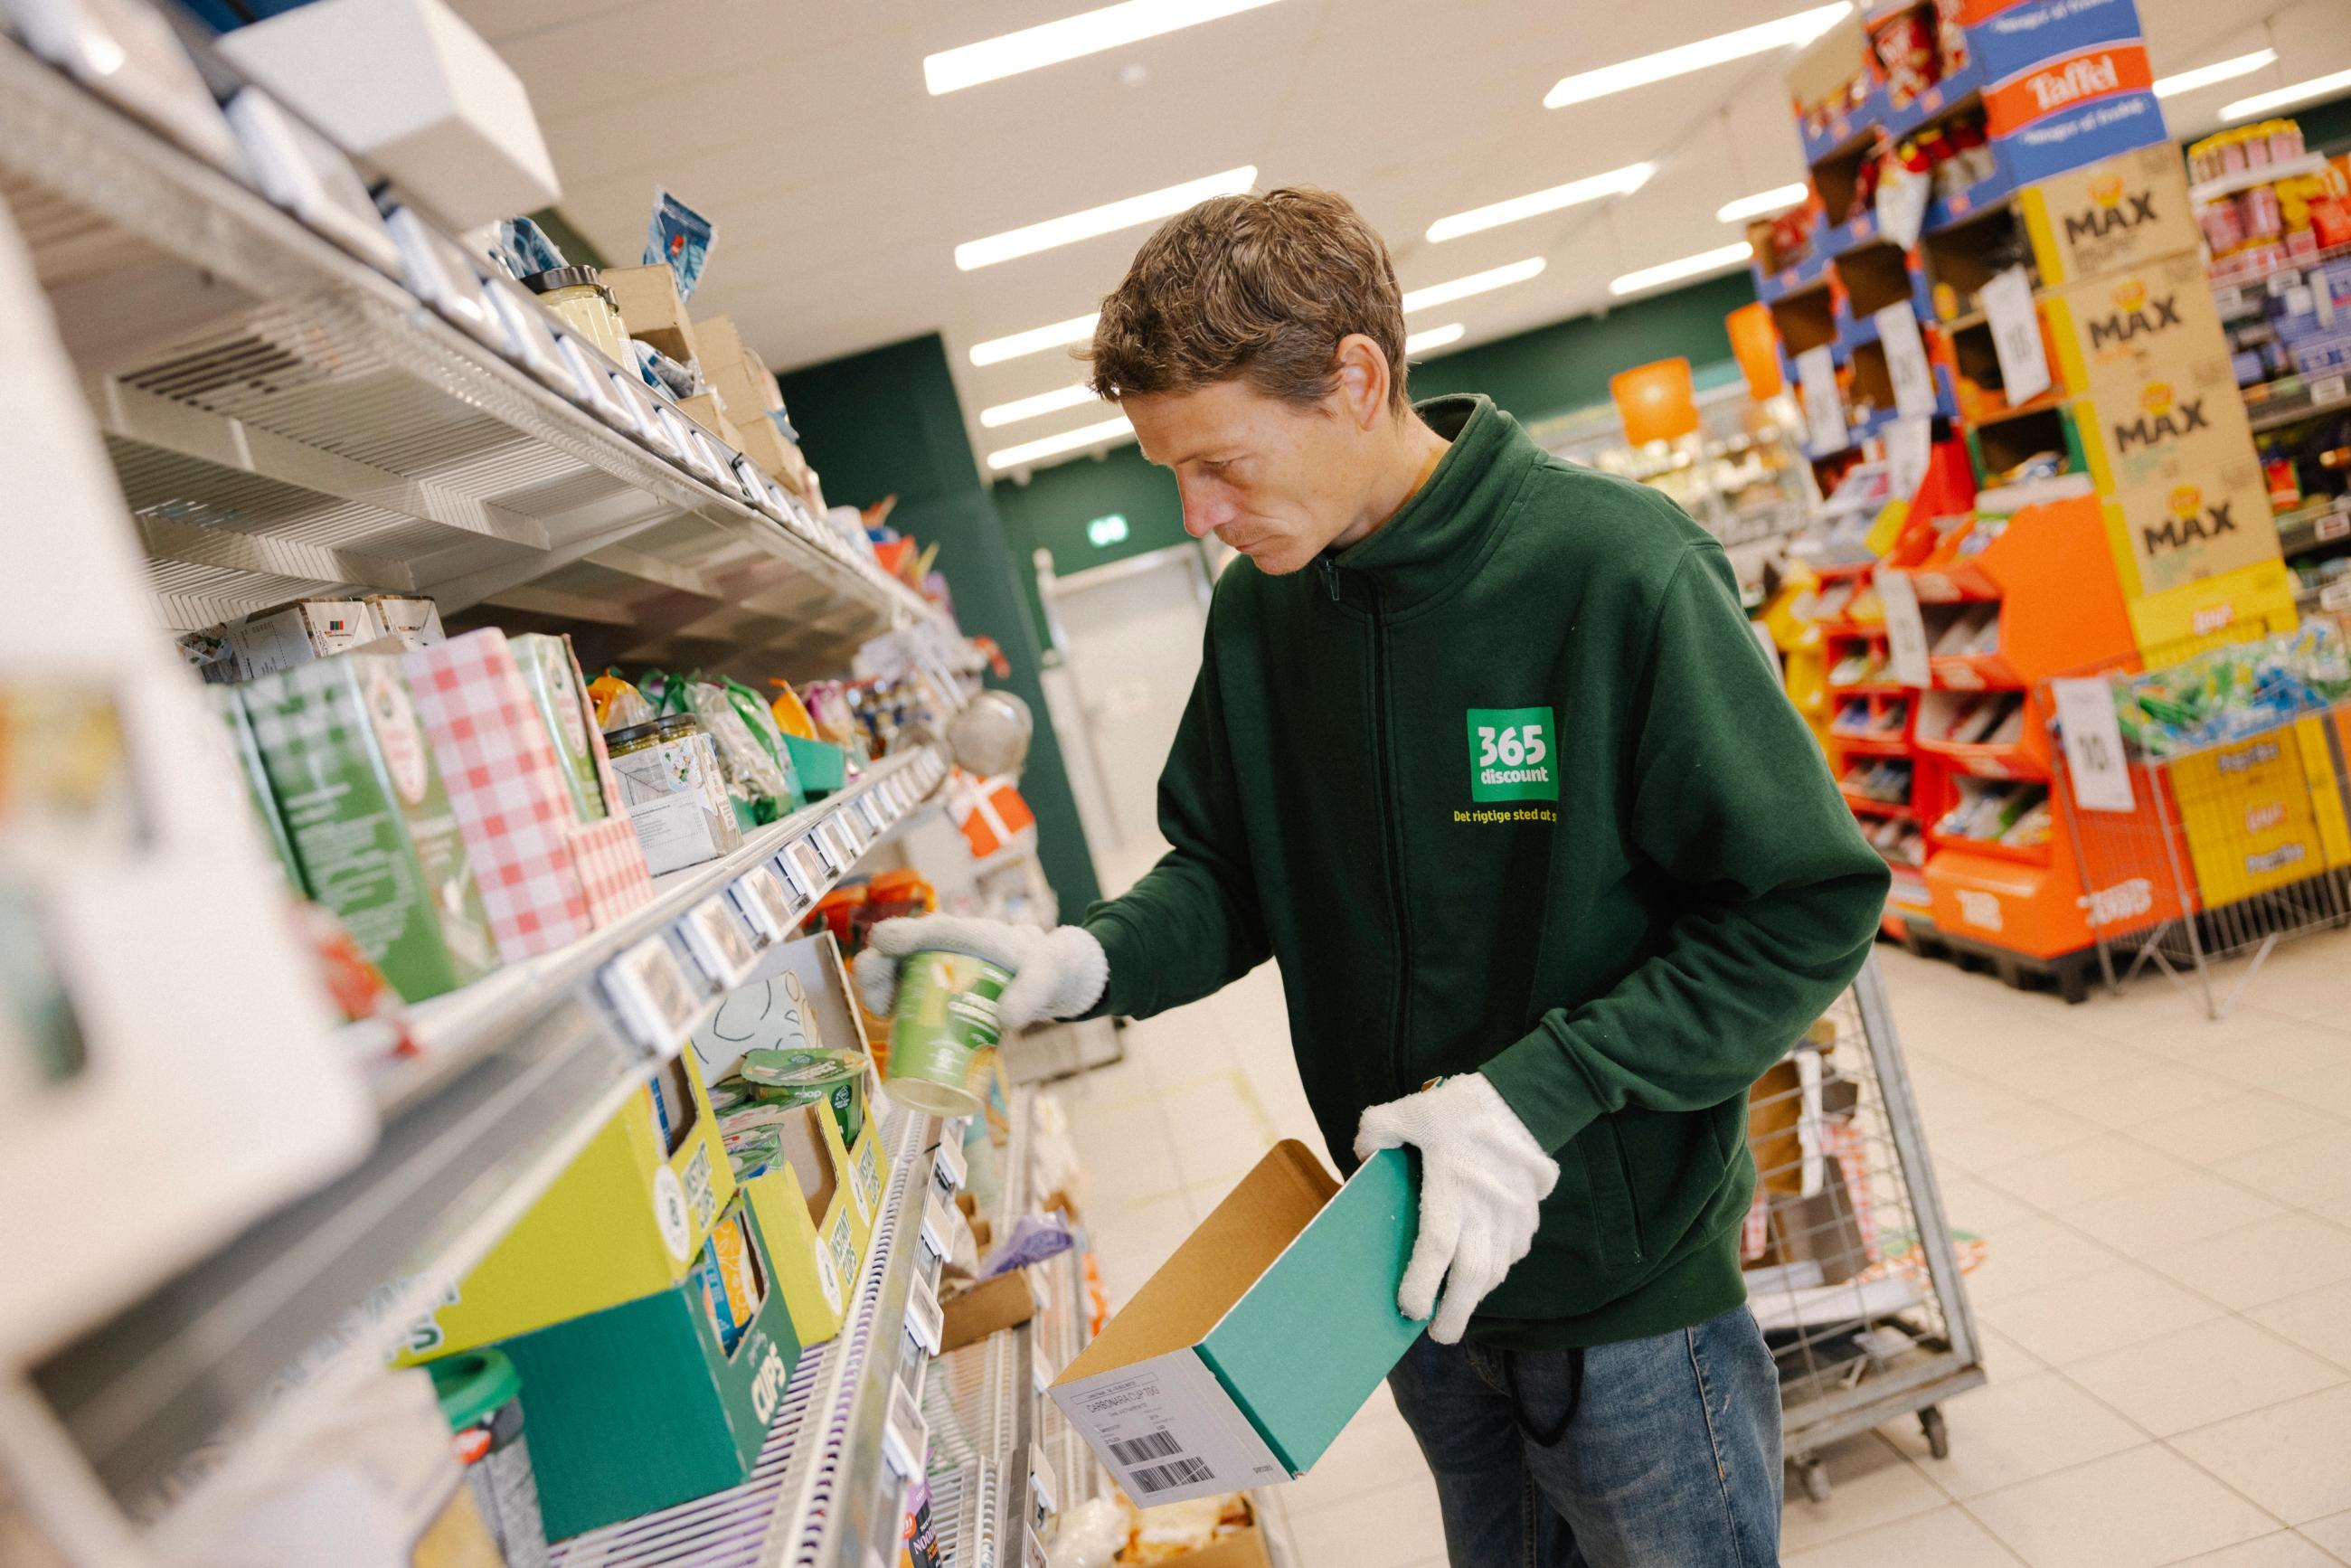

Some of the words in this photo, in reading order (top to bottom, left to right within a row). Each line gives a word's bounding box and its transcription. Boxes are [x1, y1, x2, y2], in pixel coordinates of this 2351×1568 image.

[2025, 54, 2118, 109] Taffel
[2064, 192, 2157, 245] MAX
[2089, 296, 2181, 349] MAX
[2115, 398, 2208, 453] MAX
[2144, 503, 2237, 555] MAX
[1478, 724, 1546, 767] 365
[1480, 767, 1549, 784] discount
[1454, 810, 1469, 822] Det
[1473, 809, 1511, 824] rigtige
[1513, 808, 1539, 820] sted
[1540, 810, 1551, 821] at
[829, 1205, 852, 1270] INSTANT
[842, 1242, 857, 1287] CUPS
[751, 1341, 786, 1425] CUPS
[1086, 1394, 1129, 1412] CARBONARA
